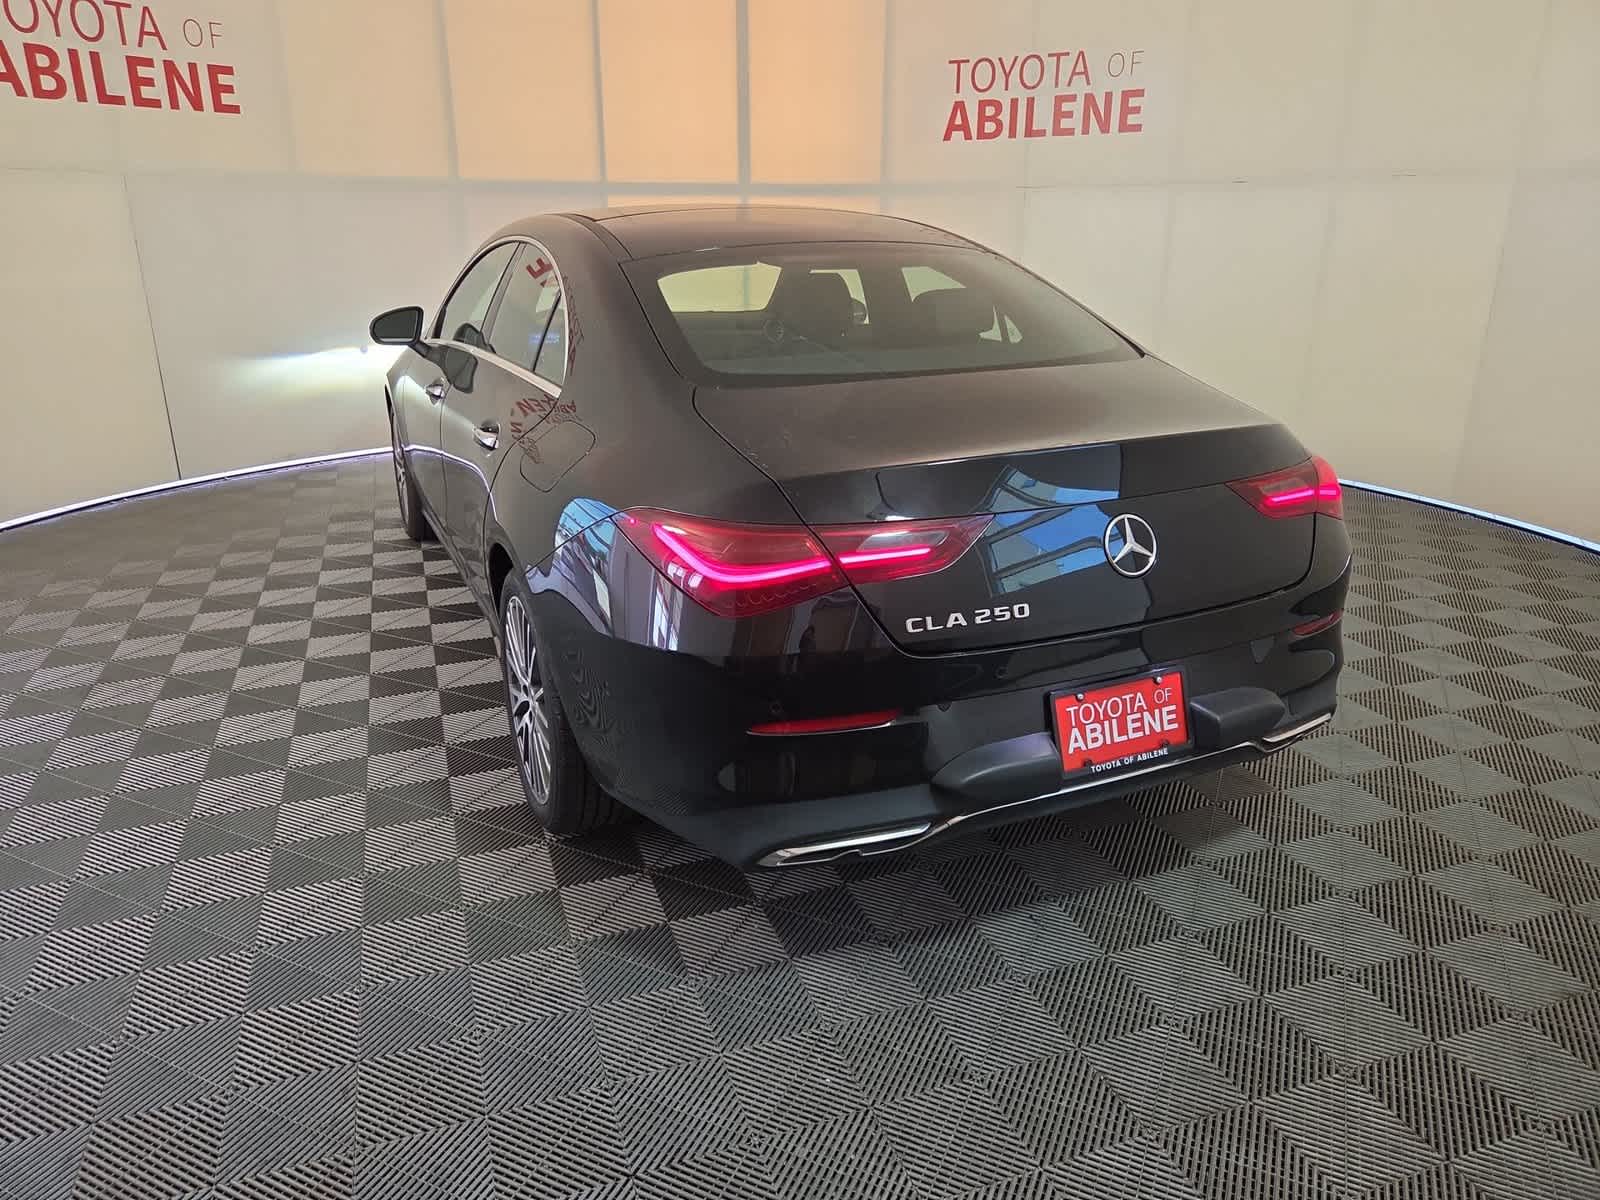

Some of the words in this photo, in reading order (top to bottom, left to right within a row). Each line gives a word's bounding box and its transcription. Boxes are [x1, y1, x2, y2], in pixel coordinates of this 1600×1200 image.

[182, 18, 223, 48] OF
[948, 50, 1091, 94] TOYOTA
[1107, 50, 1145, 78] OF
[942, 88, 1145, 142] ABILENE
[905, 612, 968, 633] CLA
[974, 603, 1030, 624] 250
[1066, 692, 1147, 727] TOYOTA
[1153, 687, 1172, 704] OF
[1068, 704, 1179, 754] ABILENE
[1091, 758, 1122, 774] TOYOTA
[1123, 756, 1134, 765] OF
[1137, 747, 1169, 763] ABILENE
